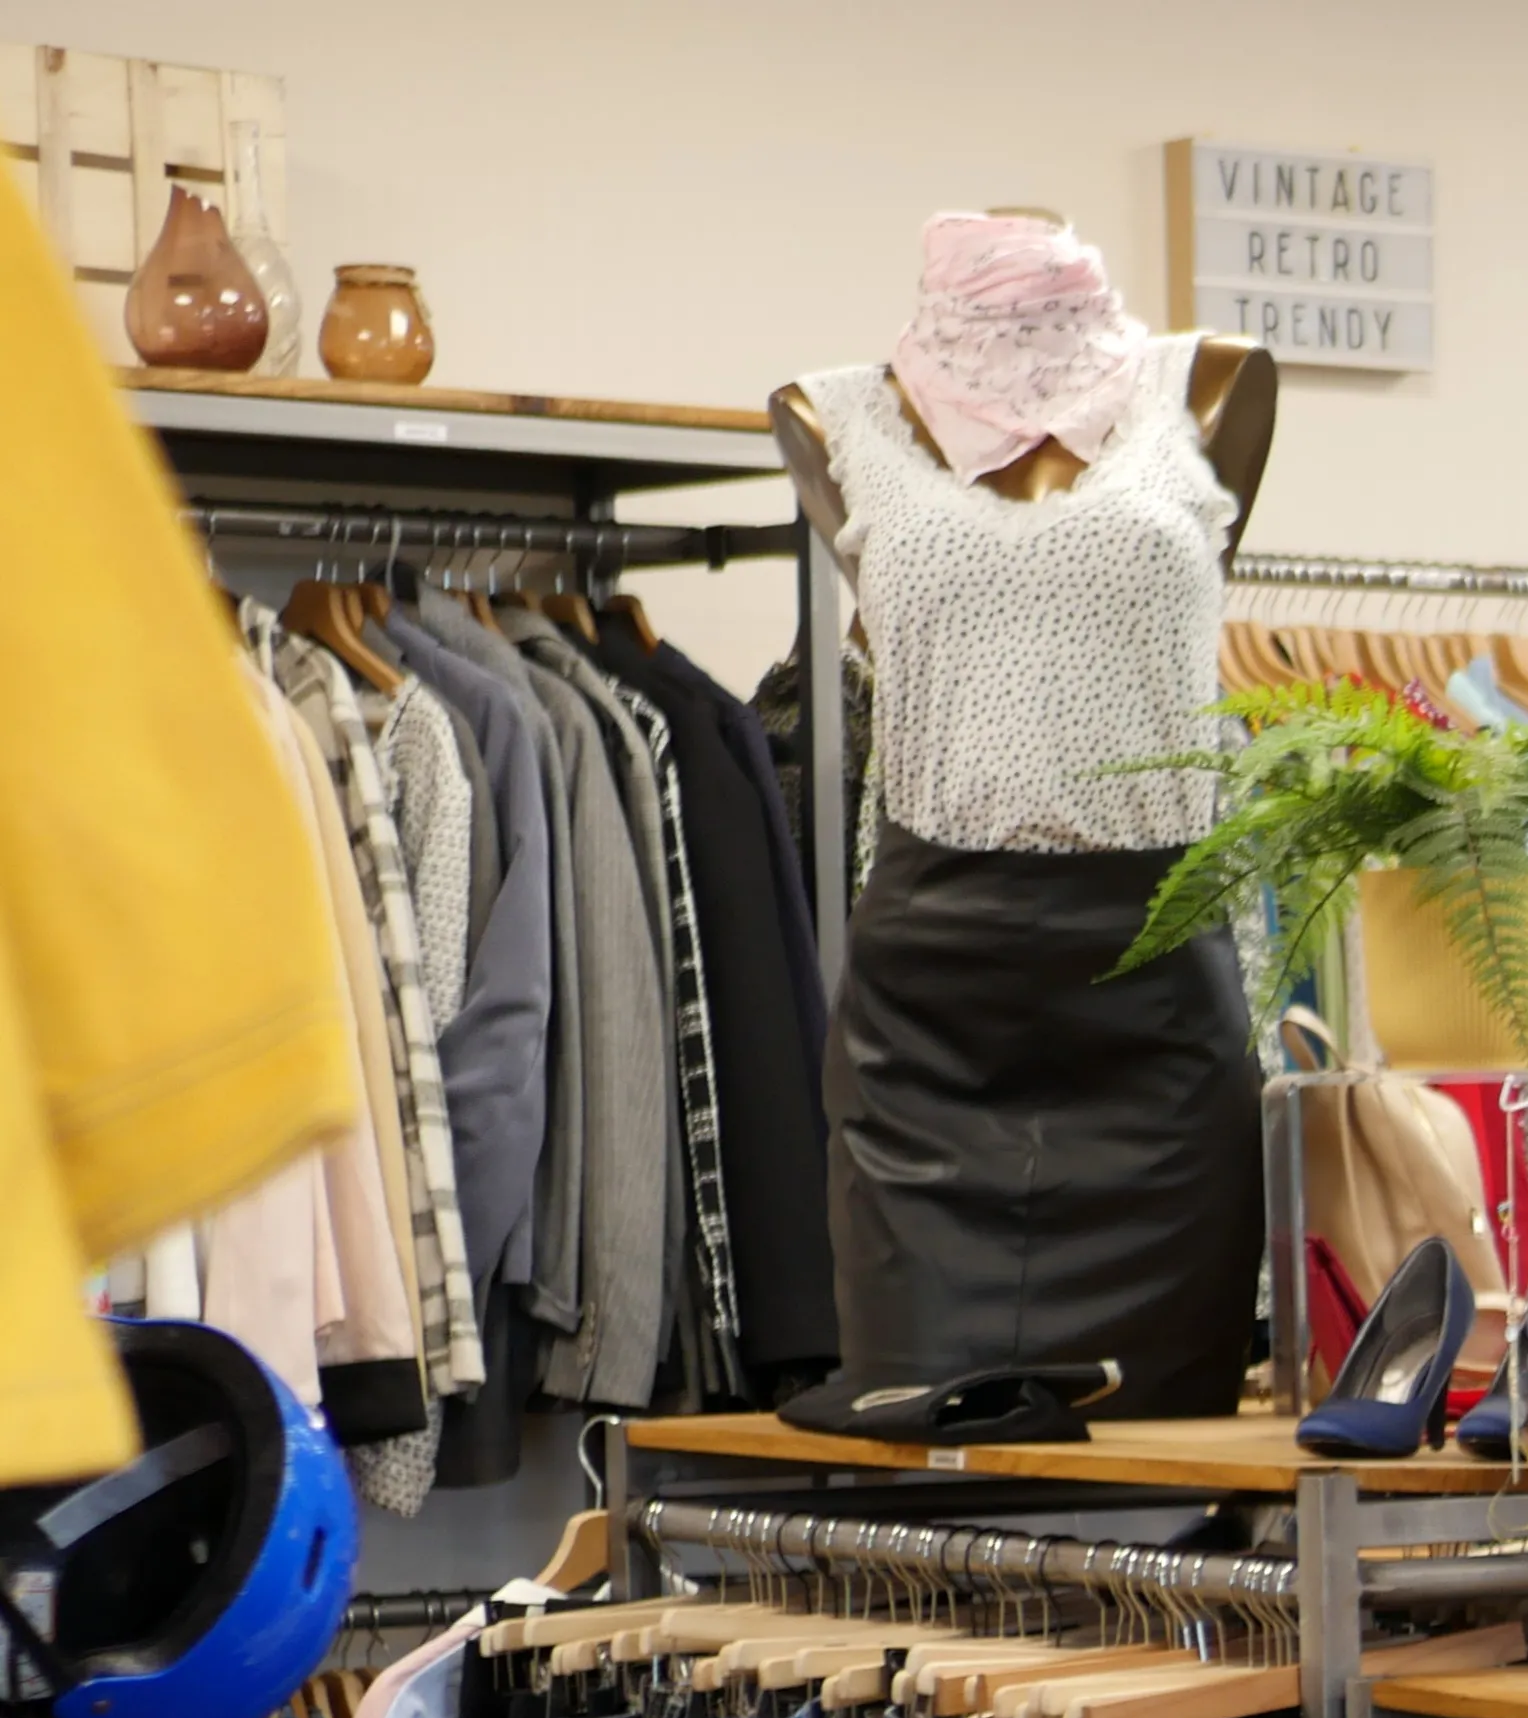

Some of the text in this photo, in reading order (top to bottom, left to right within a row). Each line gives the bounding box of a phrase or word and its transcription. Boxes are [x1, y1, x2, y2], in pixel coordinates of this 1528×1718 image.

[1217, 158, 1405, 217] VINTAGE
[1247, 230, 1379, 283] RETRO
[1233, 297, 1394, 351] TRENDY
